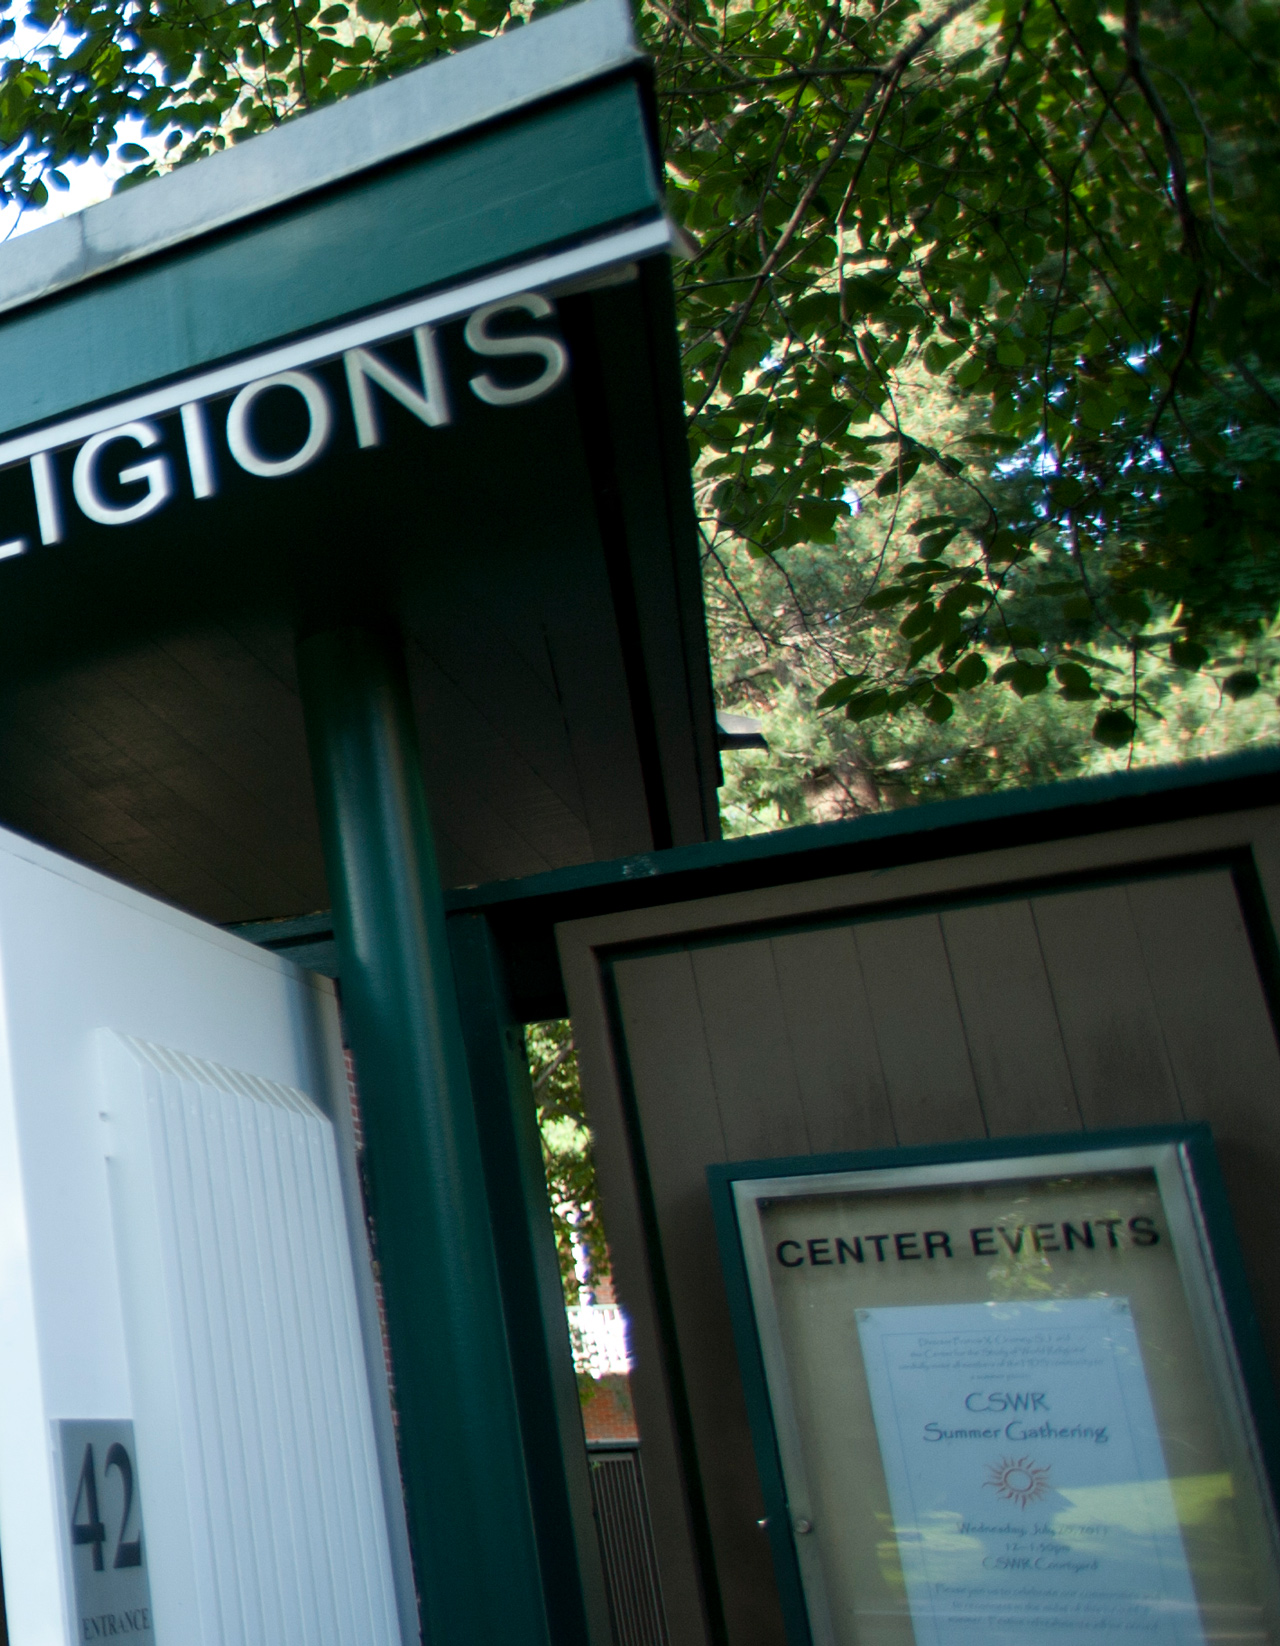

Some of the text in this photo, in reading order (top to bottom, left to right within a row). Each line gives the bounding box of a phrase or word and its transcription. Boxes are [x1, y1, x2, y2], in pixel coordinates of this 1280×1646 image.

[776, 1216, 1161, 1268] CENTER EVENTS
[965, 1391, 1050, 1413] CSWR
[924, 1419, 1109, 1444] Summer Gathering
[71, 1442, 142, 1571] 42
[982, 1555, 1031, 1570] CSWR
[82, 1607, 151, 1640] ENTRANCE
